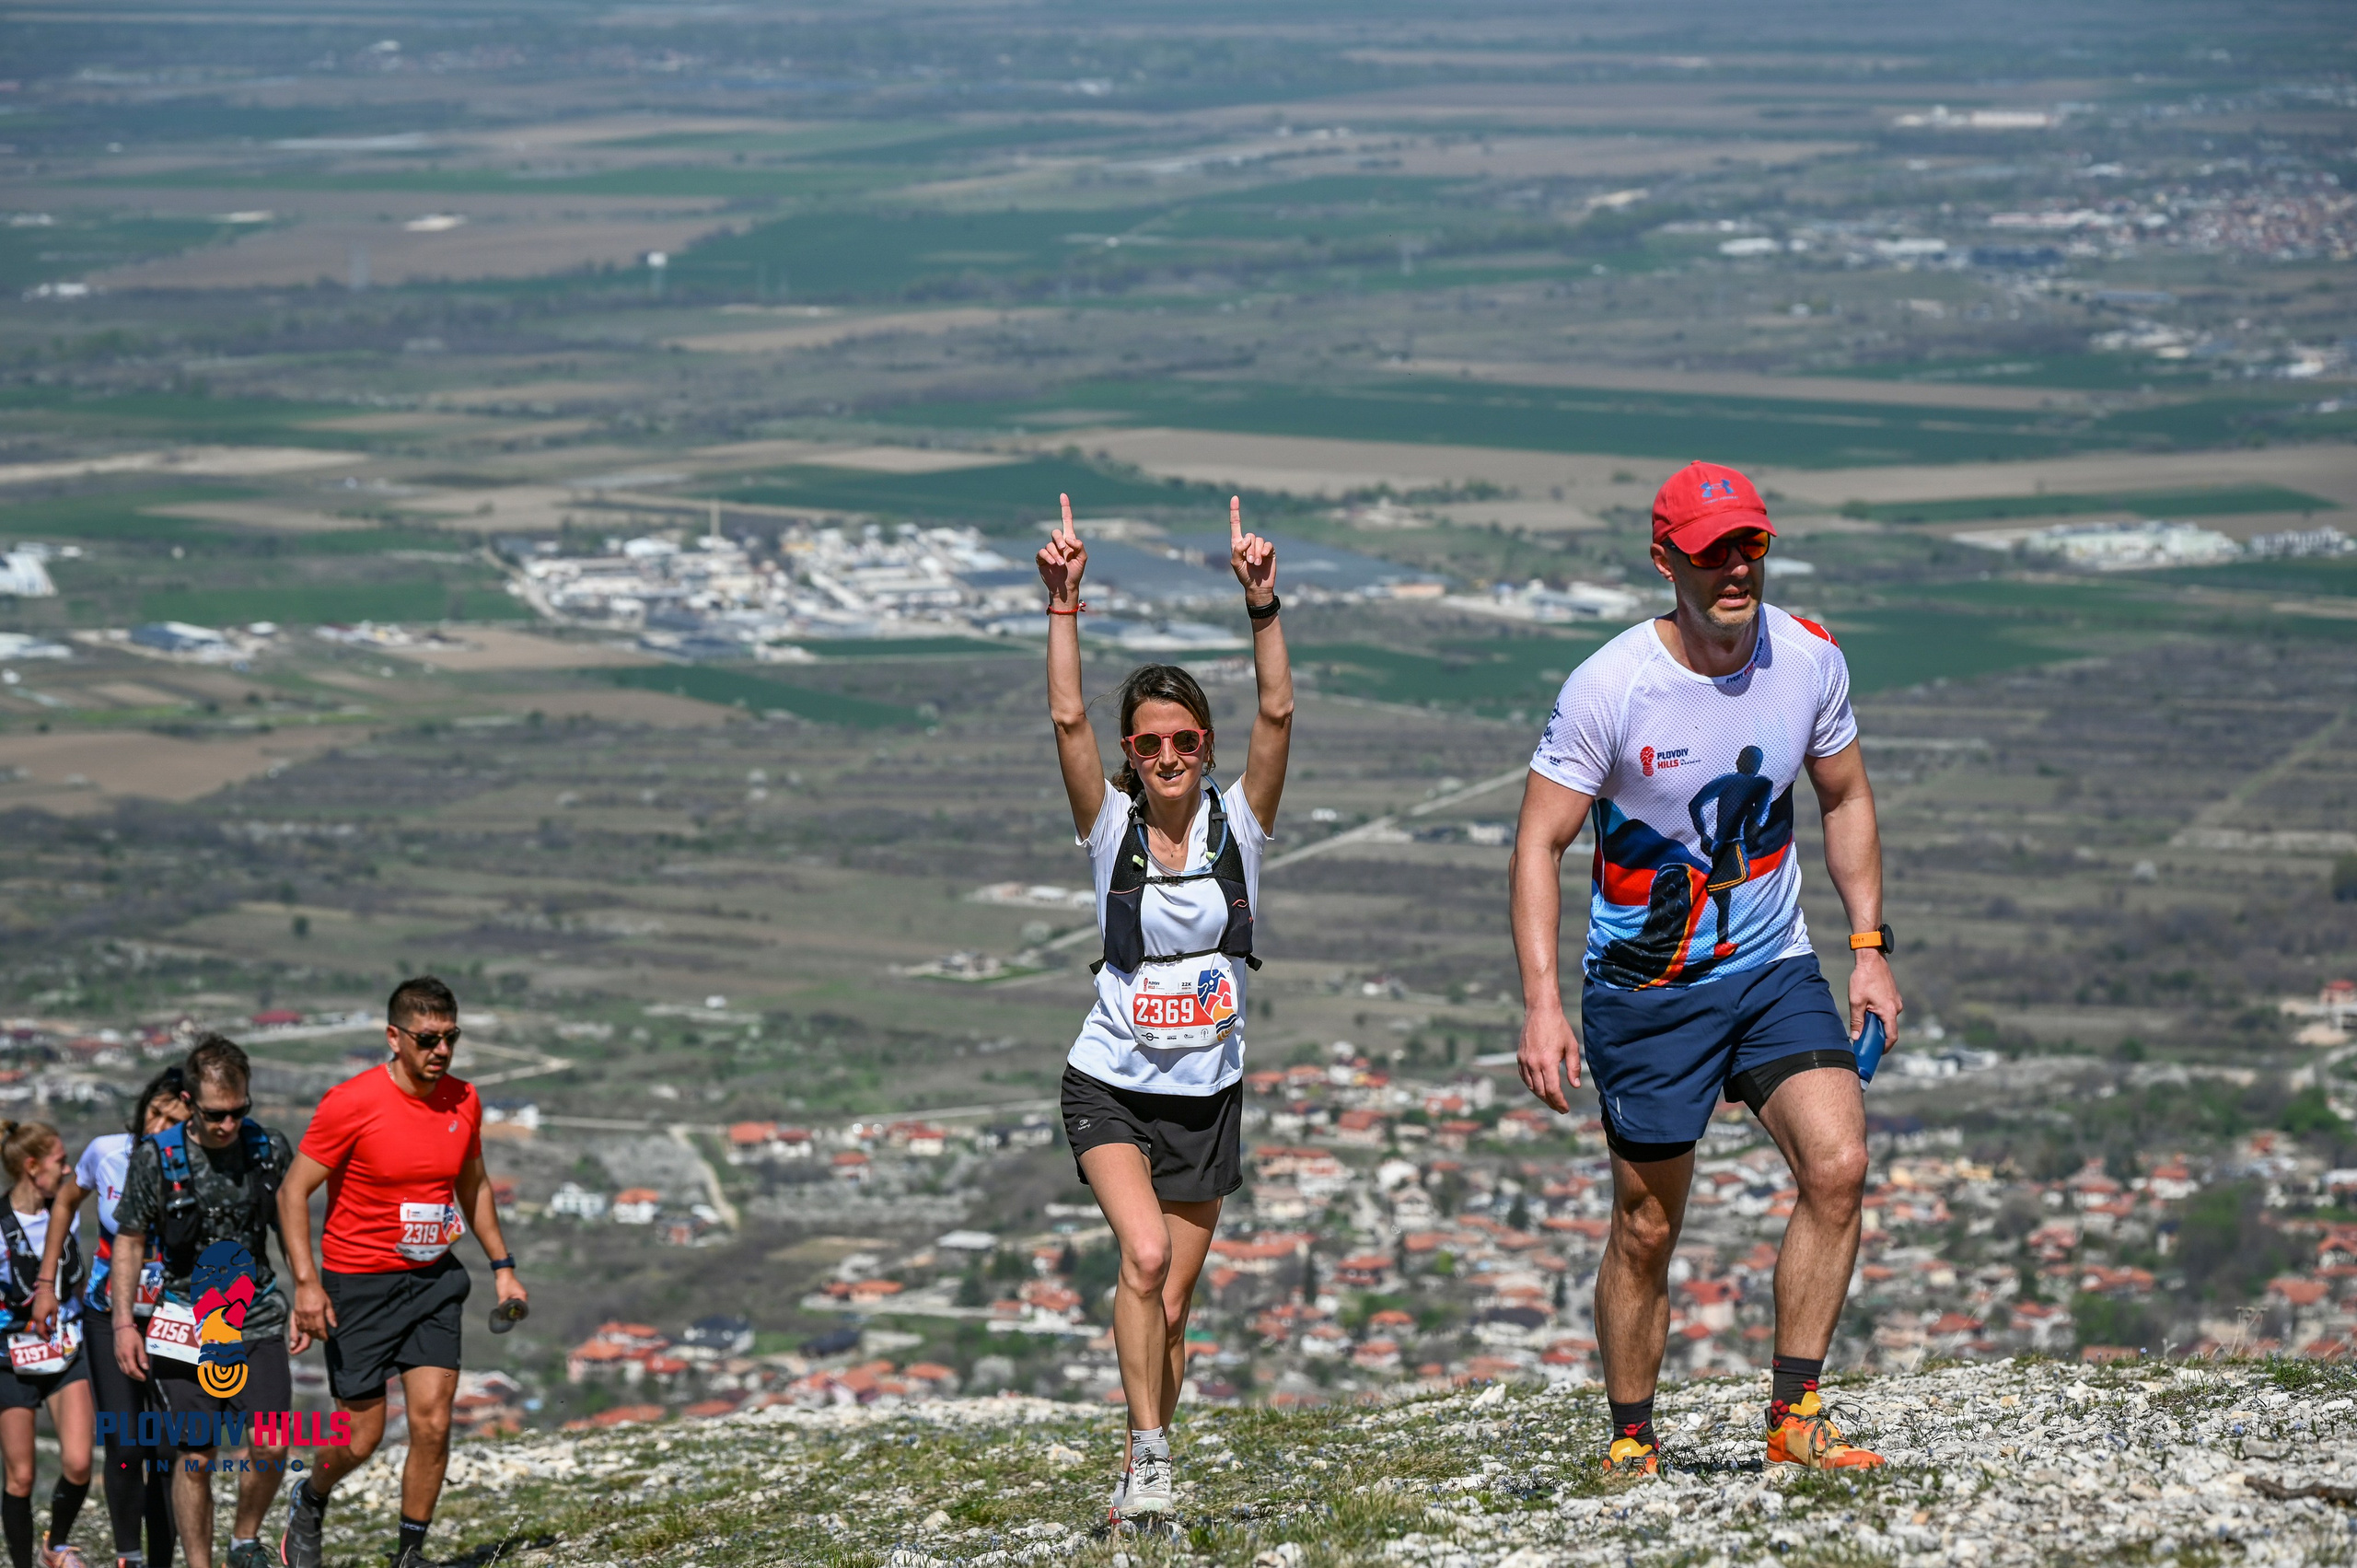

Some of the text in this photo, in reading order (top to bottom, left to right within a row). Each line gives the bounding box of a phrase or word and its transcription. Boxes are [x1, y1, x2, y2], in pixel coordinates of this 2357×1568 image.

[1657, 748, 1689, 760] PLOVDIV
[1657, 760, 1679, 769] HILLS
[1135, 997, 1194, 1024] 2369
[401, 1224, 439, 1244] 2319
[150, 1318, 191, 1343] 2156
[14, 1344, 48, 1365] 2197
